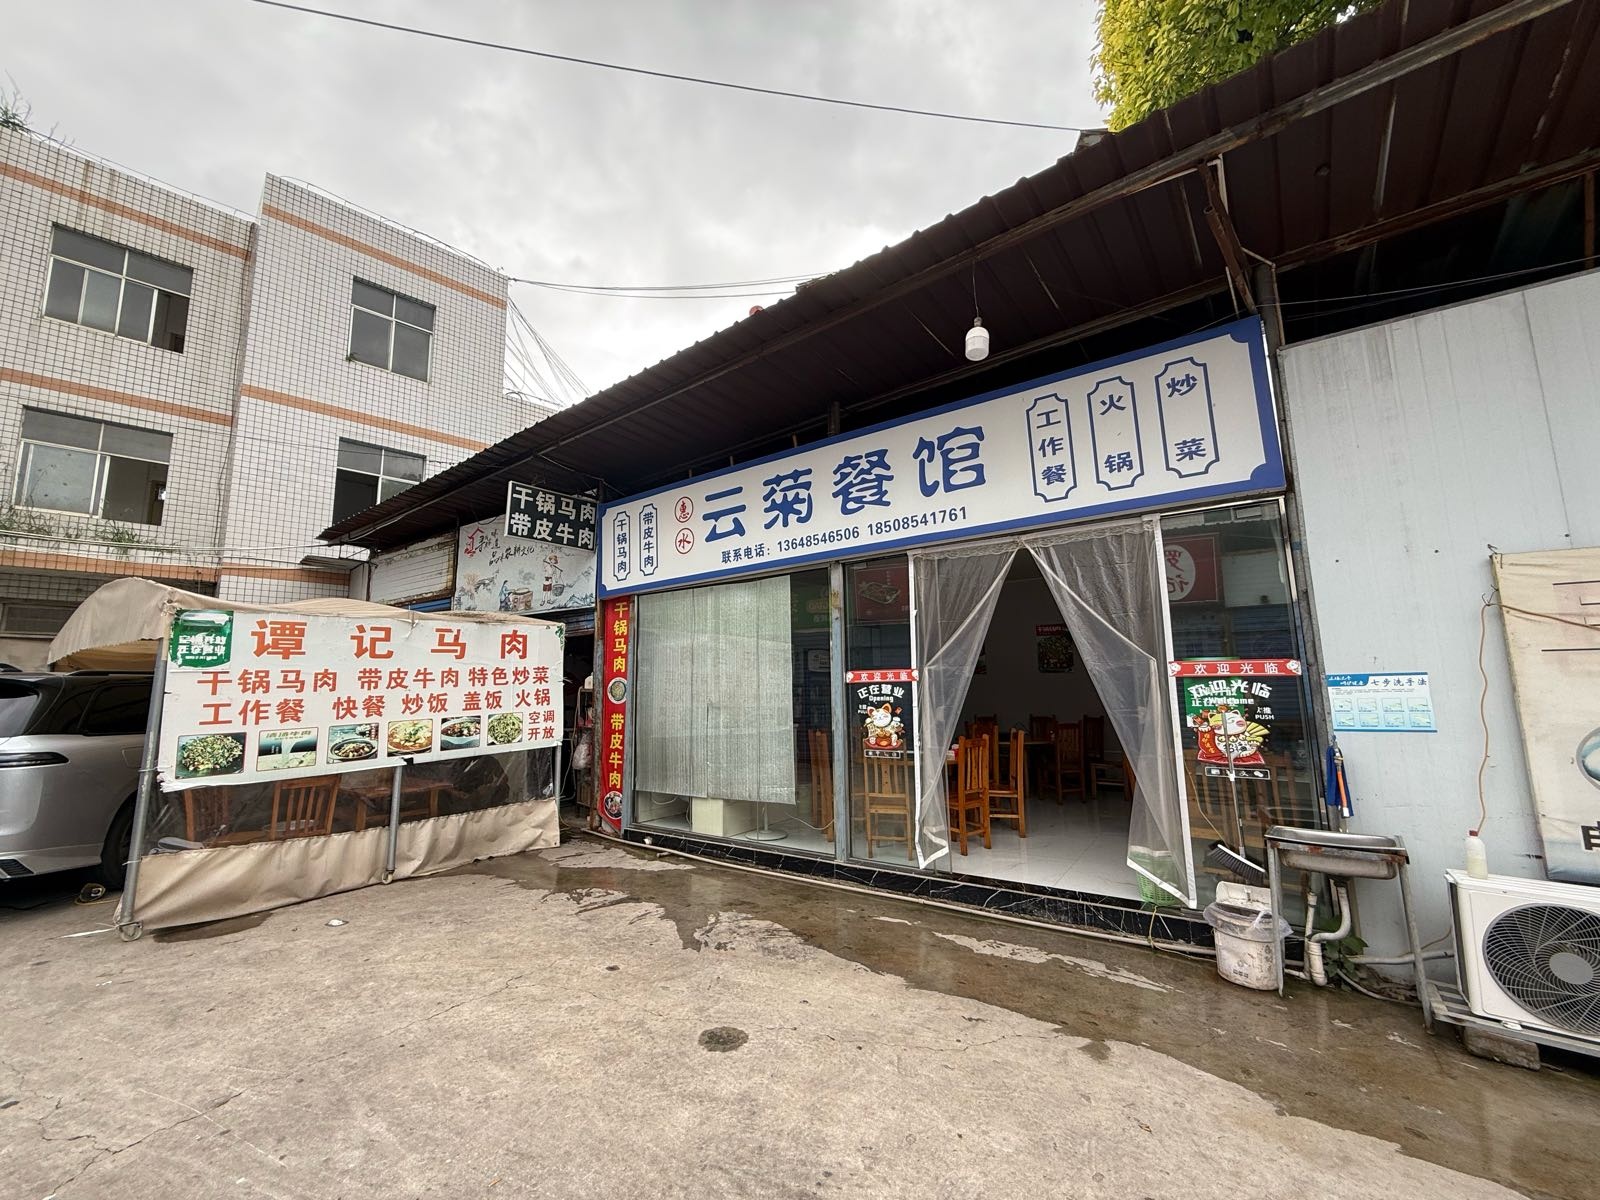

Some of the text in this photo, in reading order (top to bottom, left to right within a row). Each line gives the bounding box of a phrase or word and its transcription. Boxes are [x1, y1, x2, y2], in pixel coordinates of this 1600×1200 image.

[1099, 394, 1134, 474] 火锅
[1165, 373, 1207, 462] 炒菜
[1036, 408, 1067, 486] 工作餐
[702, 426, 986, 543] 云菊餐馆
[512, 486, 596, 525] 干锅马肉
[678, 500, 692, 550] 惠水
[510, 512, 595, 550] 带皮牛肉
[616, 518, 628, 574] 干锅马肉
[643, 511, 655, 569] 带皮牛肉
[777, 526, 860, 553] 13648546506
[867, 506, 967, 536] 18508541761
[251, 619, 528, 660] 谭记马肉
[613, 602, 629, 673] 干锅马肉
[197, 666, 550, 696] 干锅马肉 带皮牛肉 特色炒菜
[860, 671, 908, 681] 欢迎光临
[1194, 662, 1279, 675] 欢迎光临
[1371, 677, 1428, 687] 七步洗手法
[199, 688, 551, 726] 工作餐 快餐 炒饭 盖饭 火锅
[857, 683, 905, 699] 正在营业
[869, 695, 894, 703] Opening
[528, 710, 555, 725] 空调
[528, 726, 555, 741] 开放
[608, 713, 625, 789] 带皮牛肉
